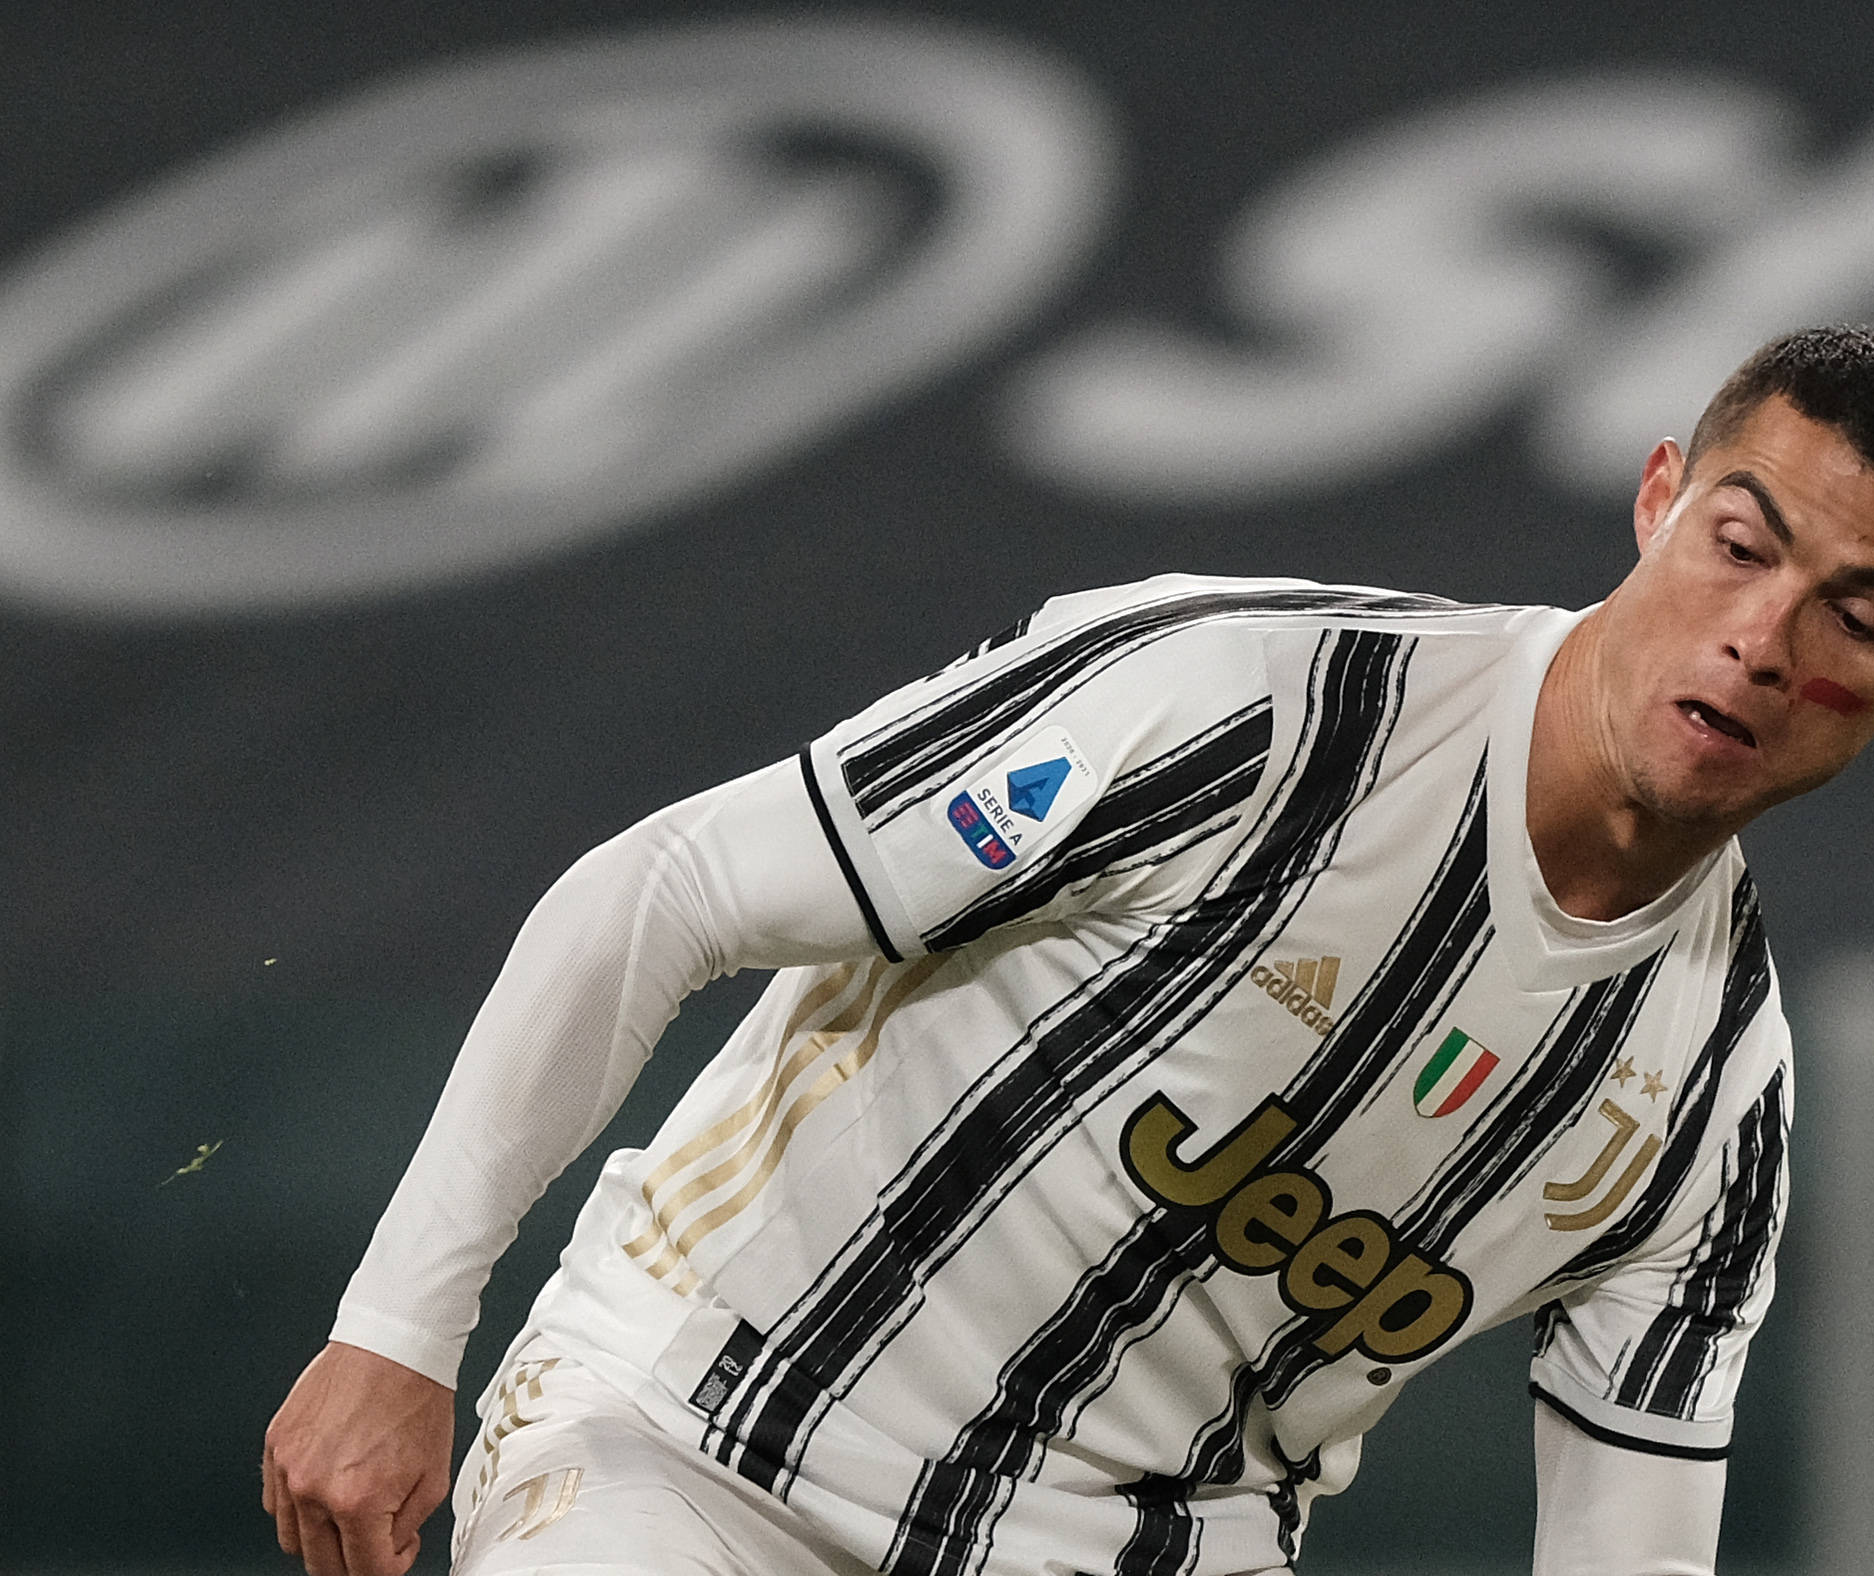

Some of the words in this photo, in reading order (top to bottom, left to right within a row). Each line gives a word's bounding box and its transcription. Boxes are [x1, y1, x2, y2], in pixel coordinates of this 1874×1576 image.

[977, 788, 1014, 833] SERIE
[1009, 833, 1023, 846] A
[1251, 966, 1333, 1036] adidas
[1119, 1090, 1474, 1364] Jeep
